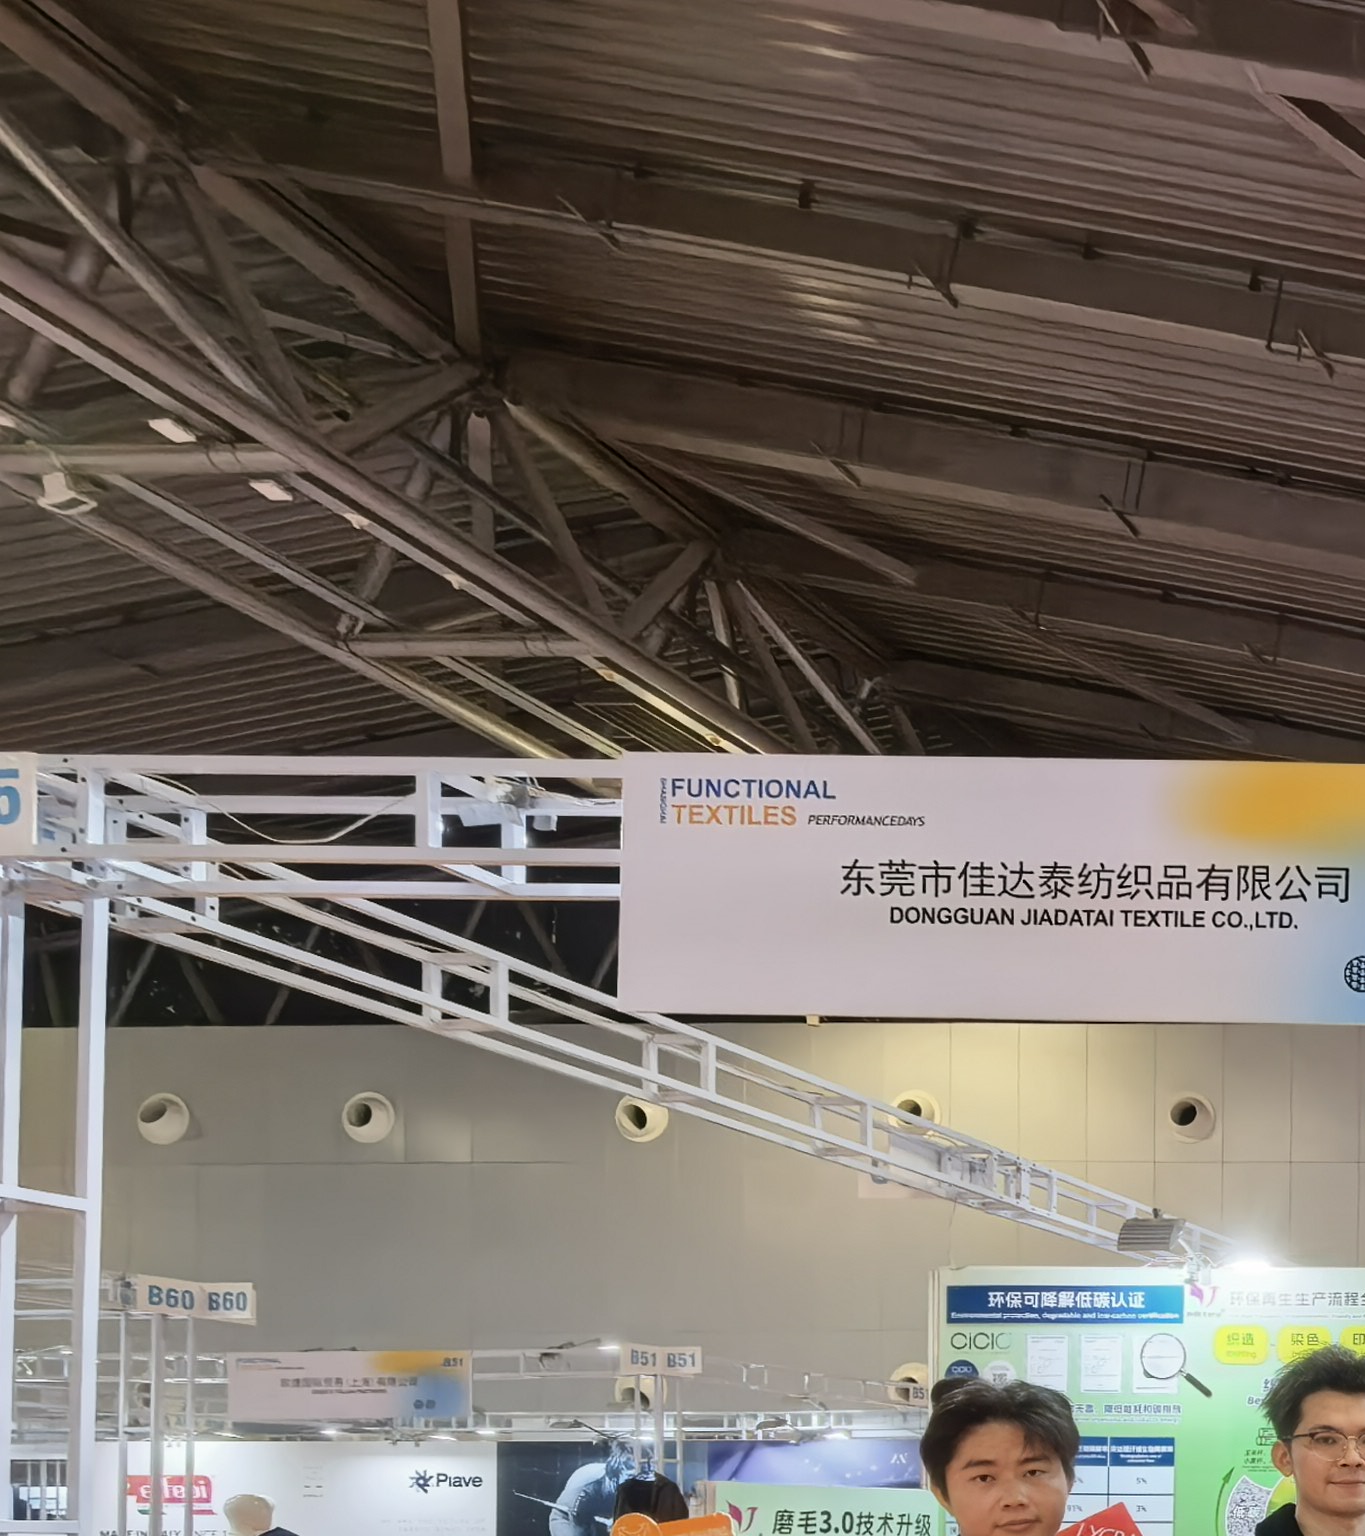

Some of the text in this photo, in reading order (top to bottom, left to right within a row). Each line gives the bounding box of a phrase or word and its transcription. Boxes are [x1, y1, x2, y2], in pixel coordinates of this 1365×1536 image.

[671, 778, 836, 800] FUNCTIONAL
[672, 804, 925, 827] TEXTILES PERFORMANCEDAYS
[840, 859, 1351, 904] 东莞市佳达泰纺织品有限公司
[890, 907, 1014, 925] DONGGUAN
[1021, 908, 1114, 927] JIADATAI
[1121, 910, 1205, 928] TEXTILE
[148, 1285, 195, 1310] B60
[208, 1291, 247, 1312] B60
[988, 1291, 1146, 1308] 环保可降解低碳认证
[1291, 1333, 1320, 1346] 染色
[631, 1349, 657, 1367] B51
[667, 1353, 696, 1368] B51
[913, 1387, 928, 1399] B5
[436, 1473, 483, 1488] Piave
[772, 1509, 931, 1536] 磨毛3.0技术升级
